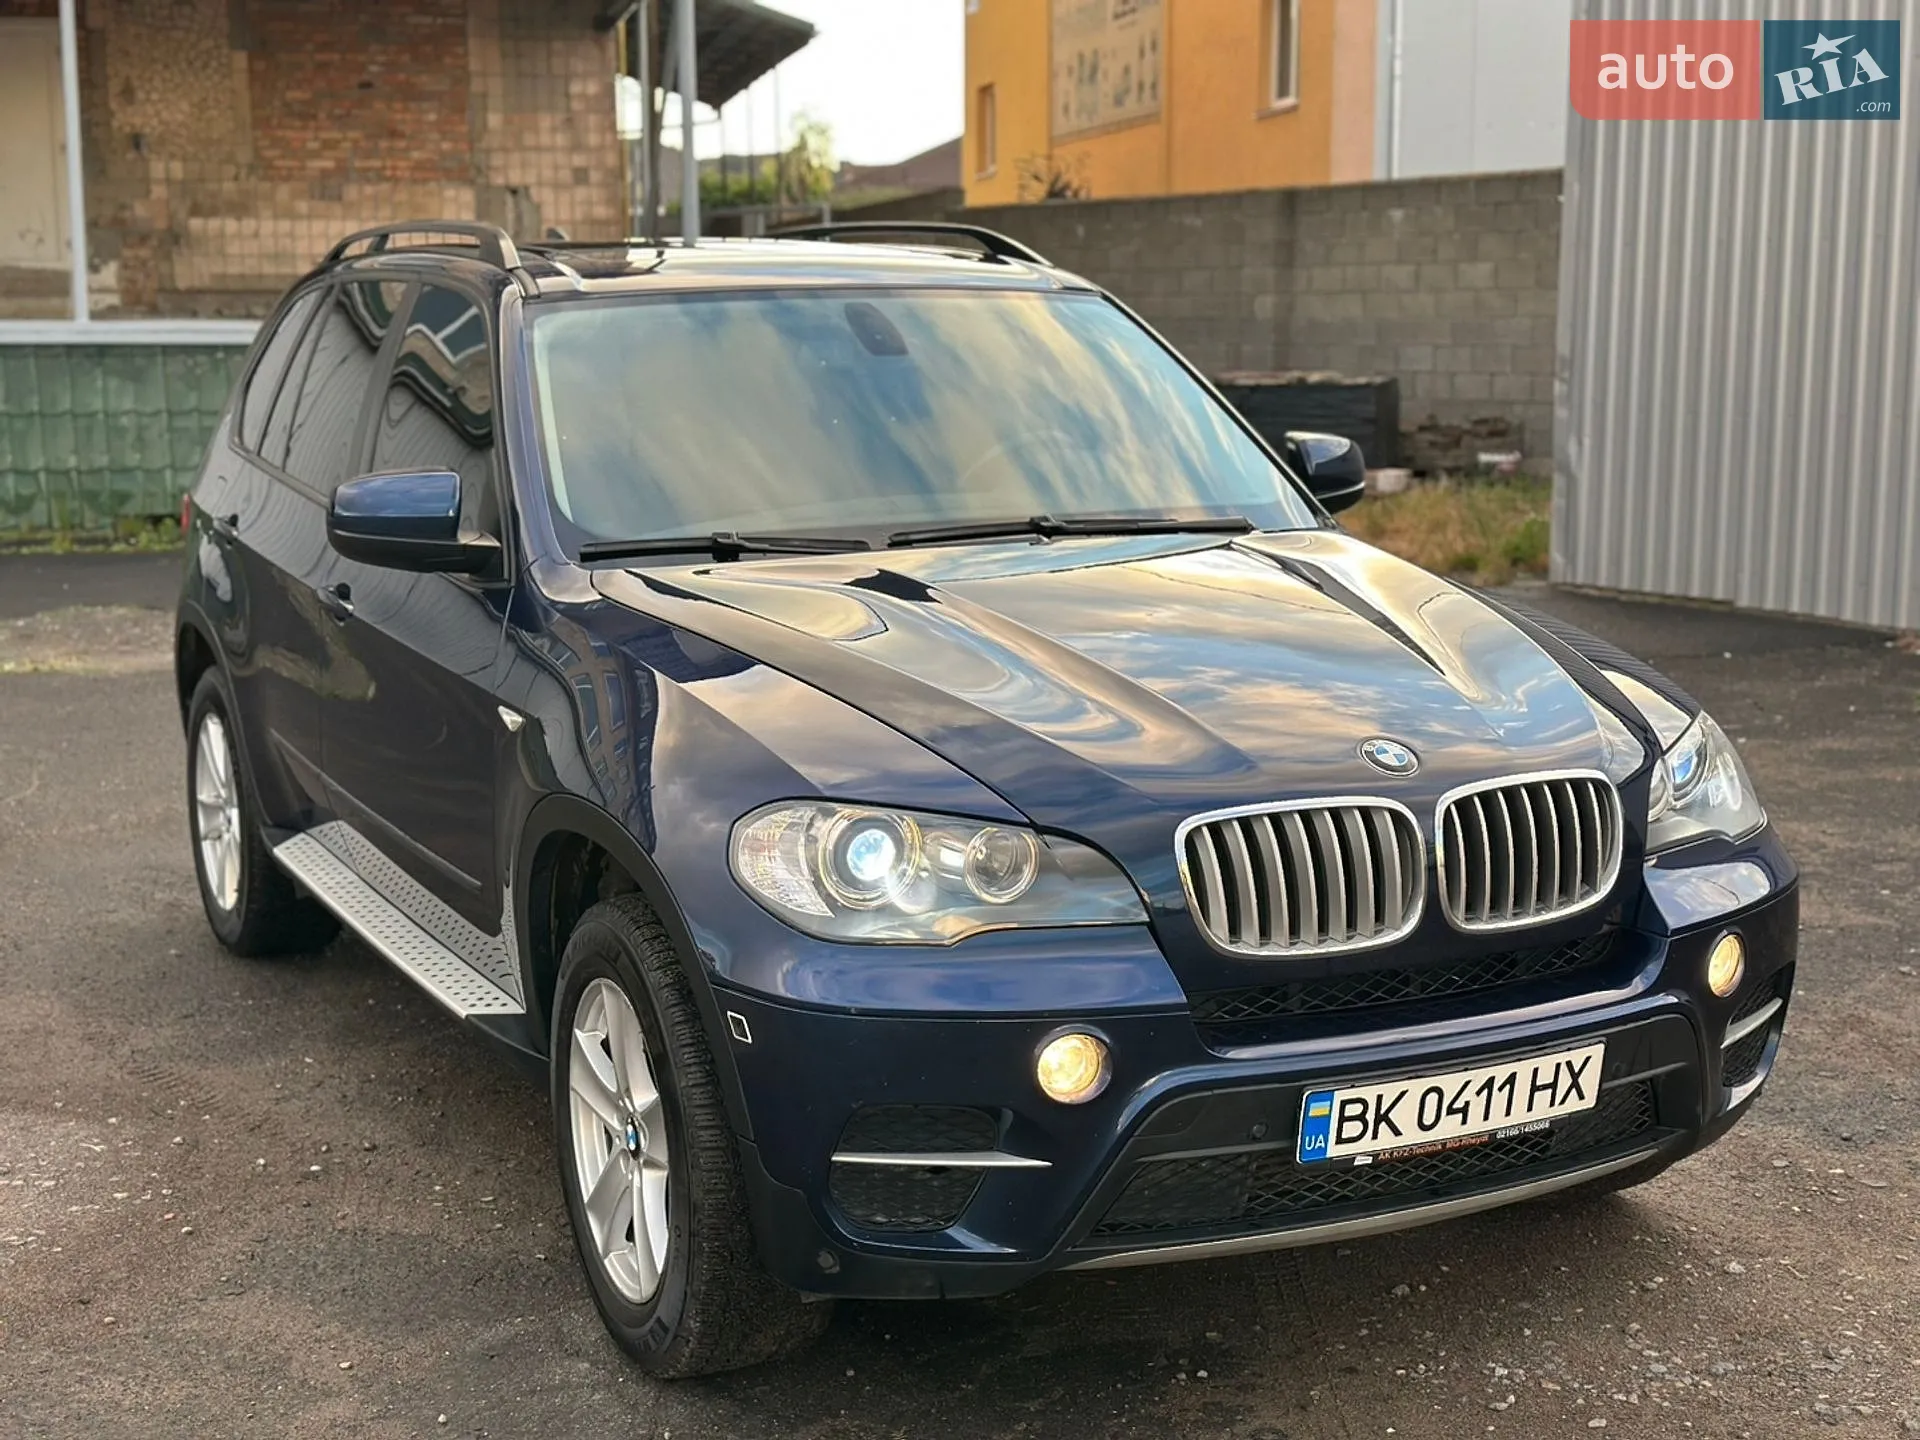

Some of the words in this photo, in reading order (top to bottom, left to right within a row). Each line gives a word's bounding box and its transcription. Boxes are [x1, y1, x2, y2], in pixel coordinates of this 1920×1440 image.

[1334, 1089, 1409, 1146] BK
[1417, 1071, 1518, 1133] 0411
[1526, 1055, 1593, 1113] HX
[1304, 1133, 1326, 1151] UA
